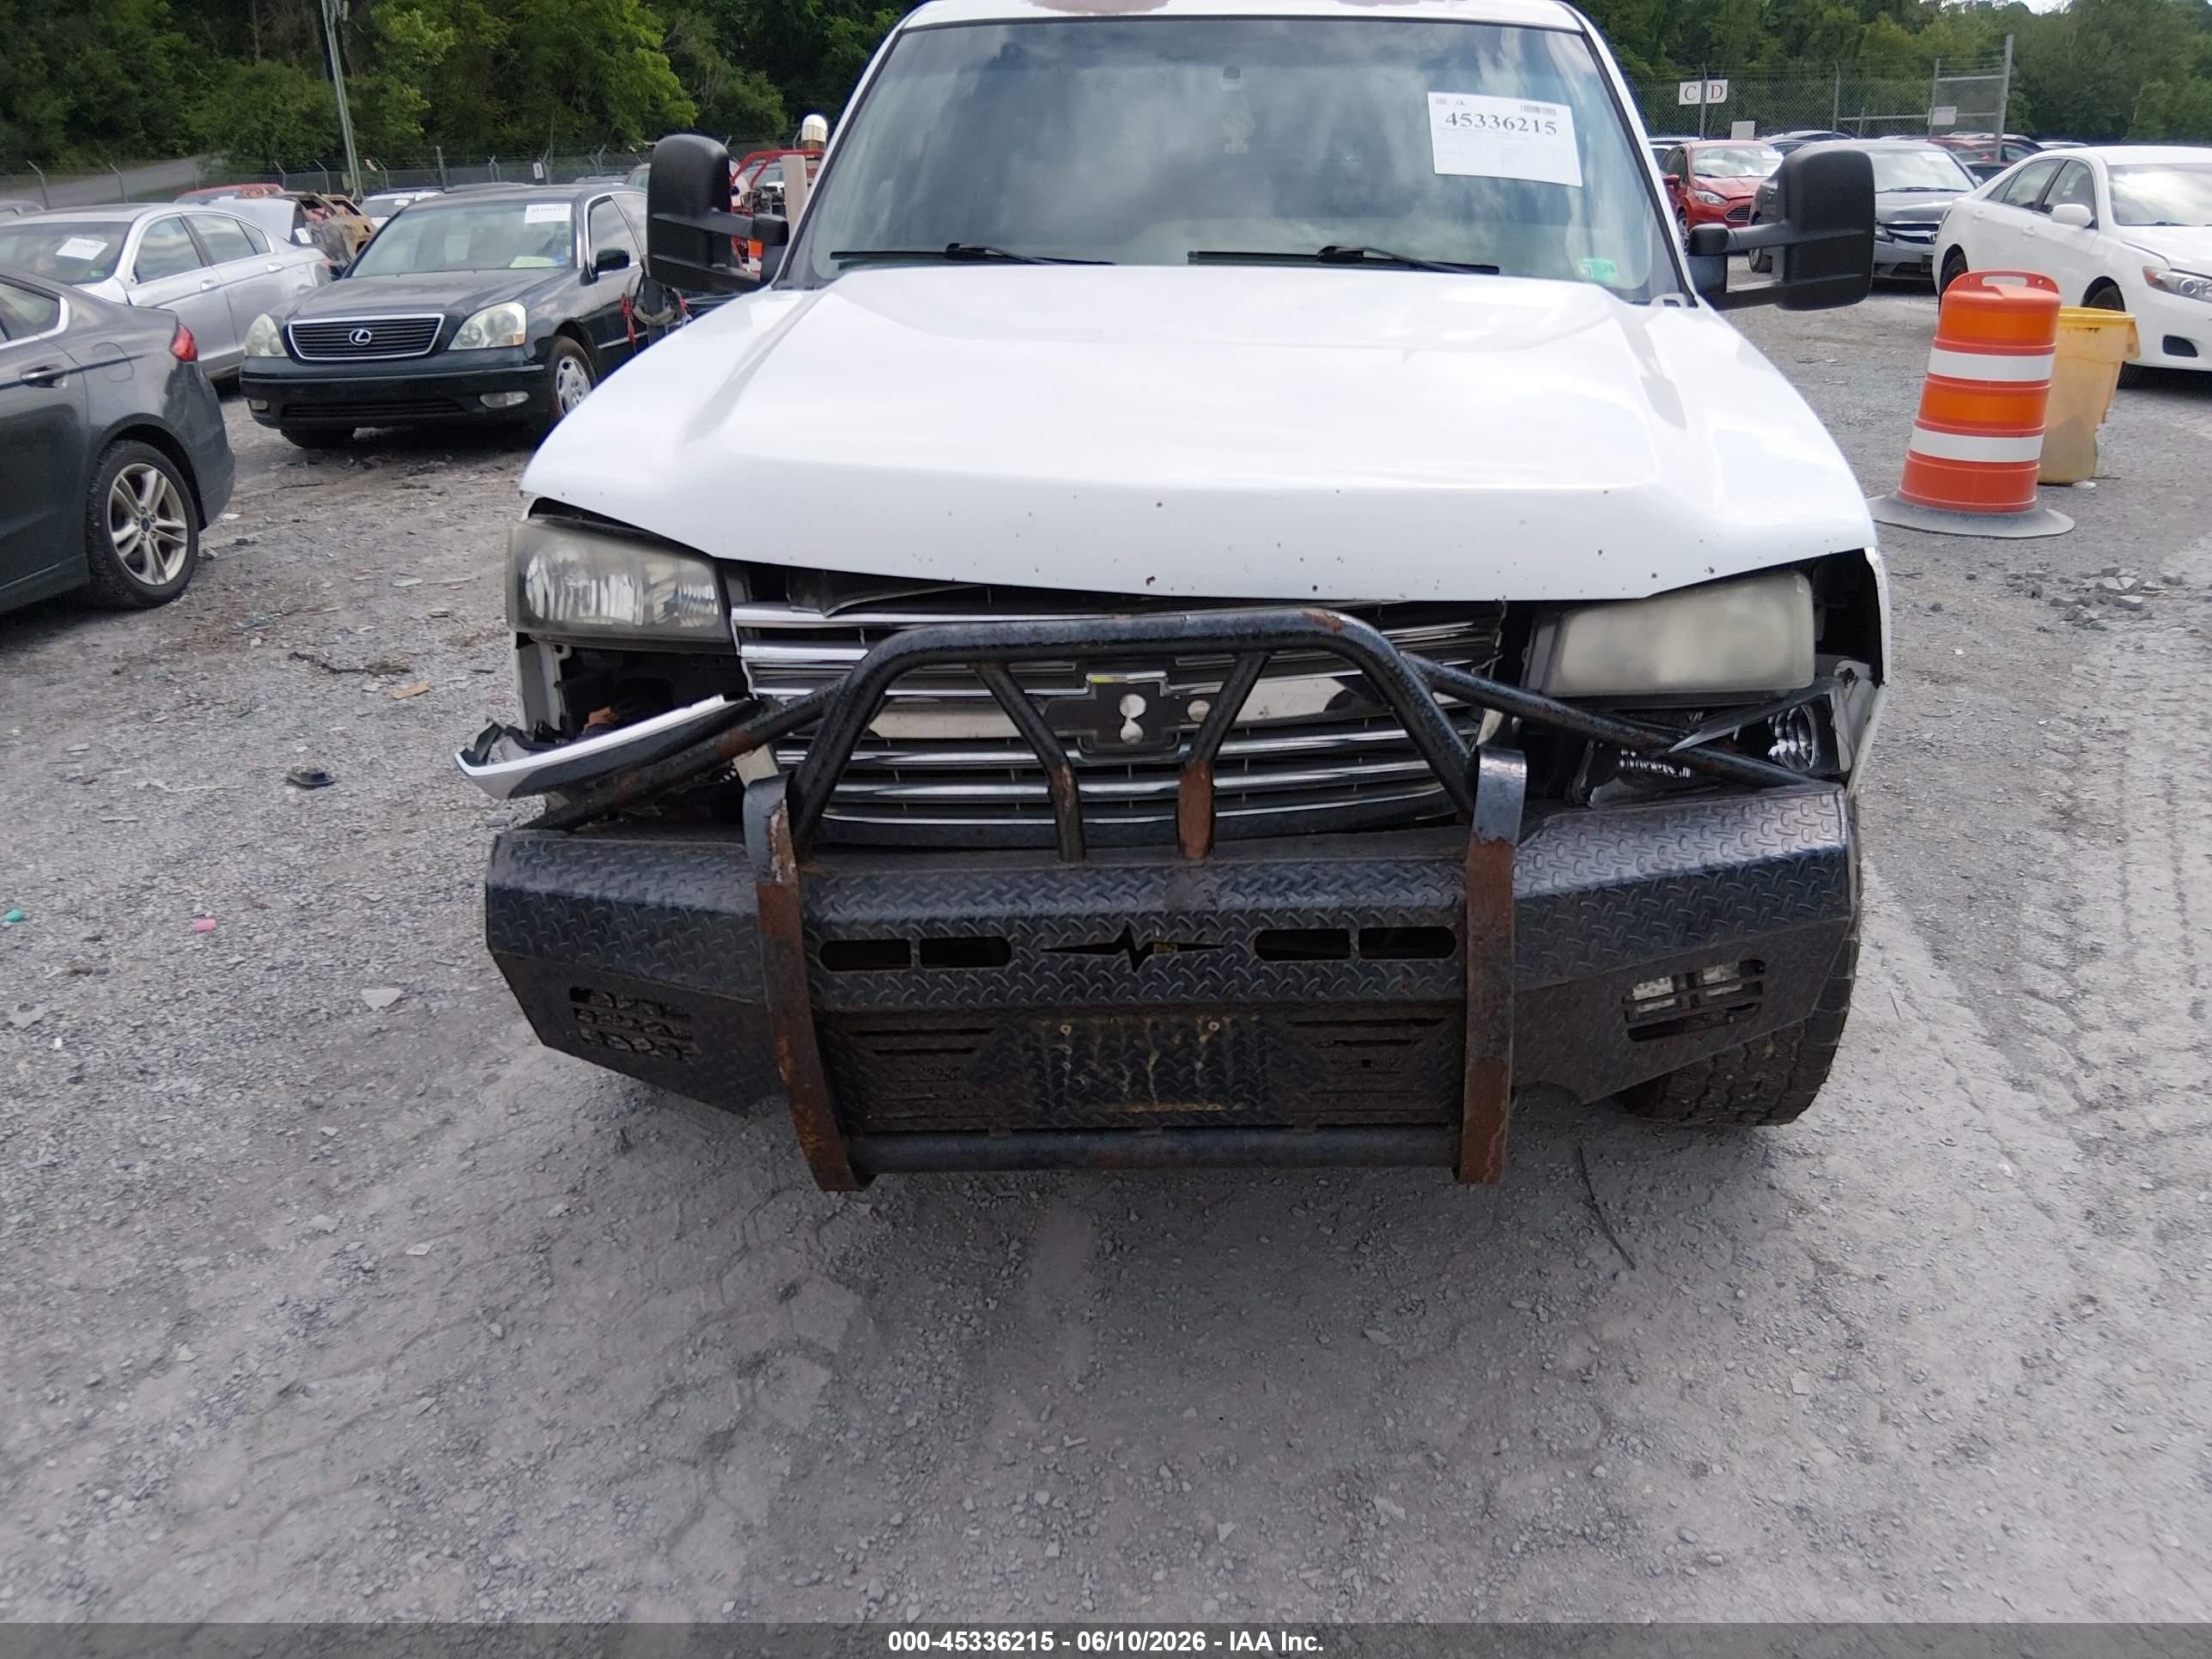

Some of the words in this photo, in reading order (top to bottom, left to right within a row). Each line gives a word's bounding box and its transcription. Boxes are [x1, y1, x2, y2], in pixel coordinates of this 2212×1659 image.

[1684, 85, 1697, 100] C
[1710, 84, 1723, 99] D
[1445, 112, 1558, 136] 45336215
